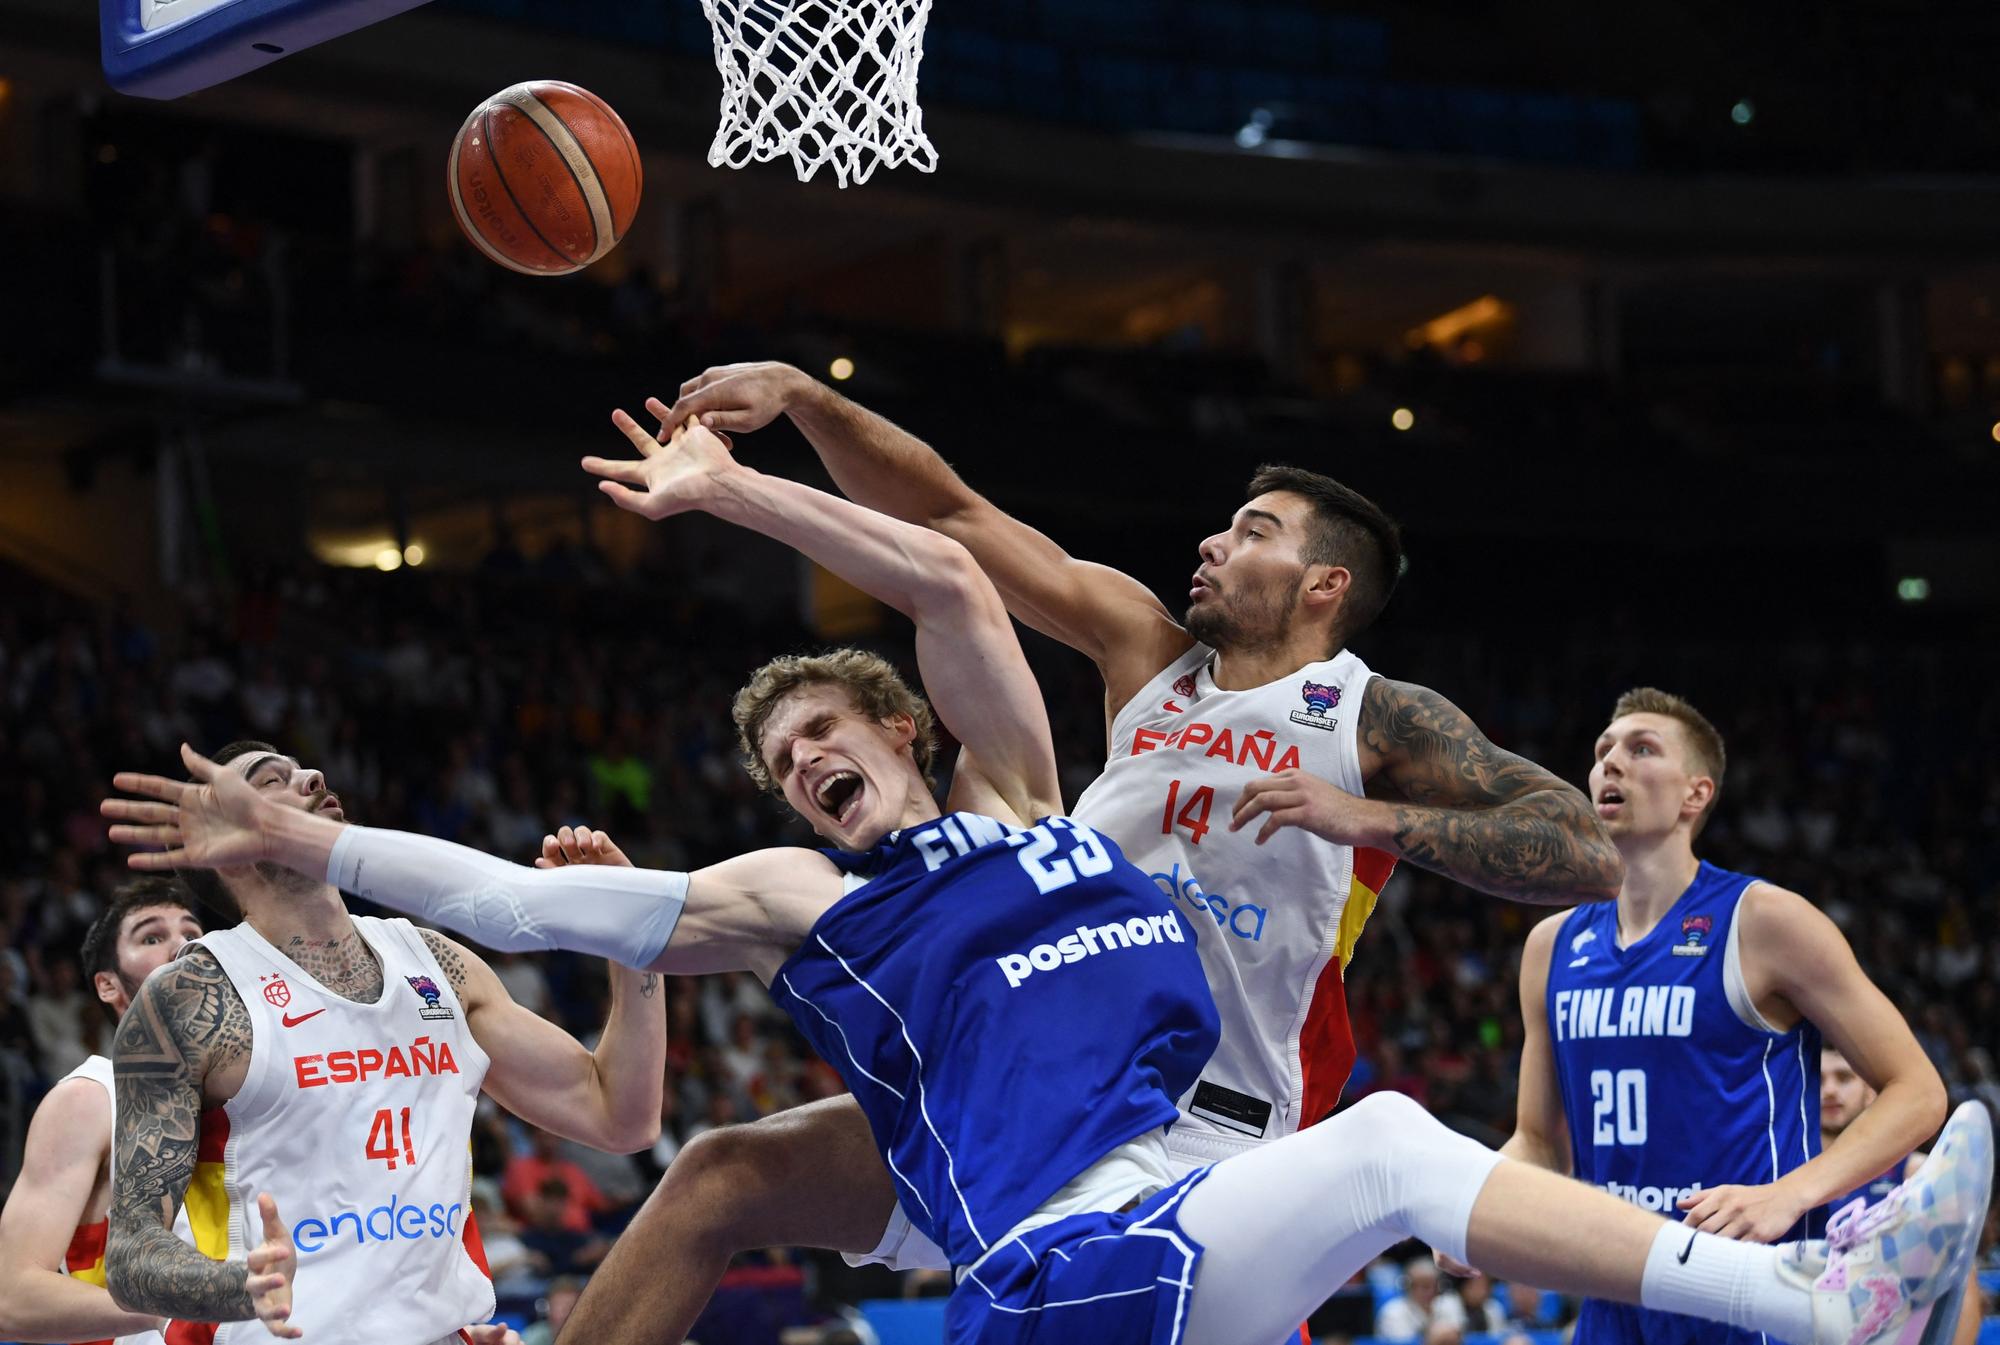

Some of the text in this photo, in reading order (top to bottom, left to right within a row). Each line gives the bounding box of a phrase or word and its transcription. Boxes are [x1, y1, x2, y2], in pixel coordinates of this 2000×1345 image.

[468, 171, 518, 247] molten
[1162, 780, 1215, 845] 14
[1004, 815, 1113, 895] 23
[1150, 863, 1267, 941] desa
[996, 910, 1185, 988] postnord
[1556, 985, 1696, 1042] FINLAND
[293, 1036, 460, 1089] ESPAÑA
[365, 1107, 416, 1170] 41
[1590, 1069, 1648, 1146] 20
[1598, 1181, 1702, 1212] tnord
